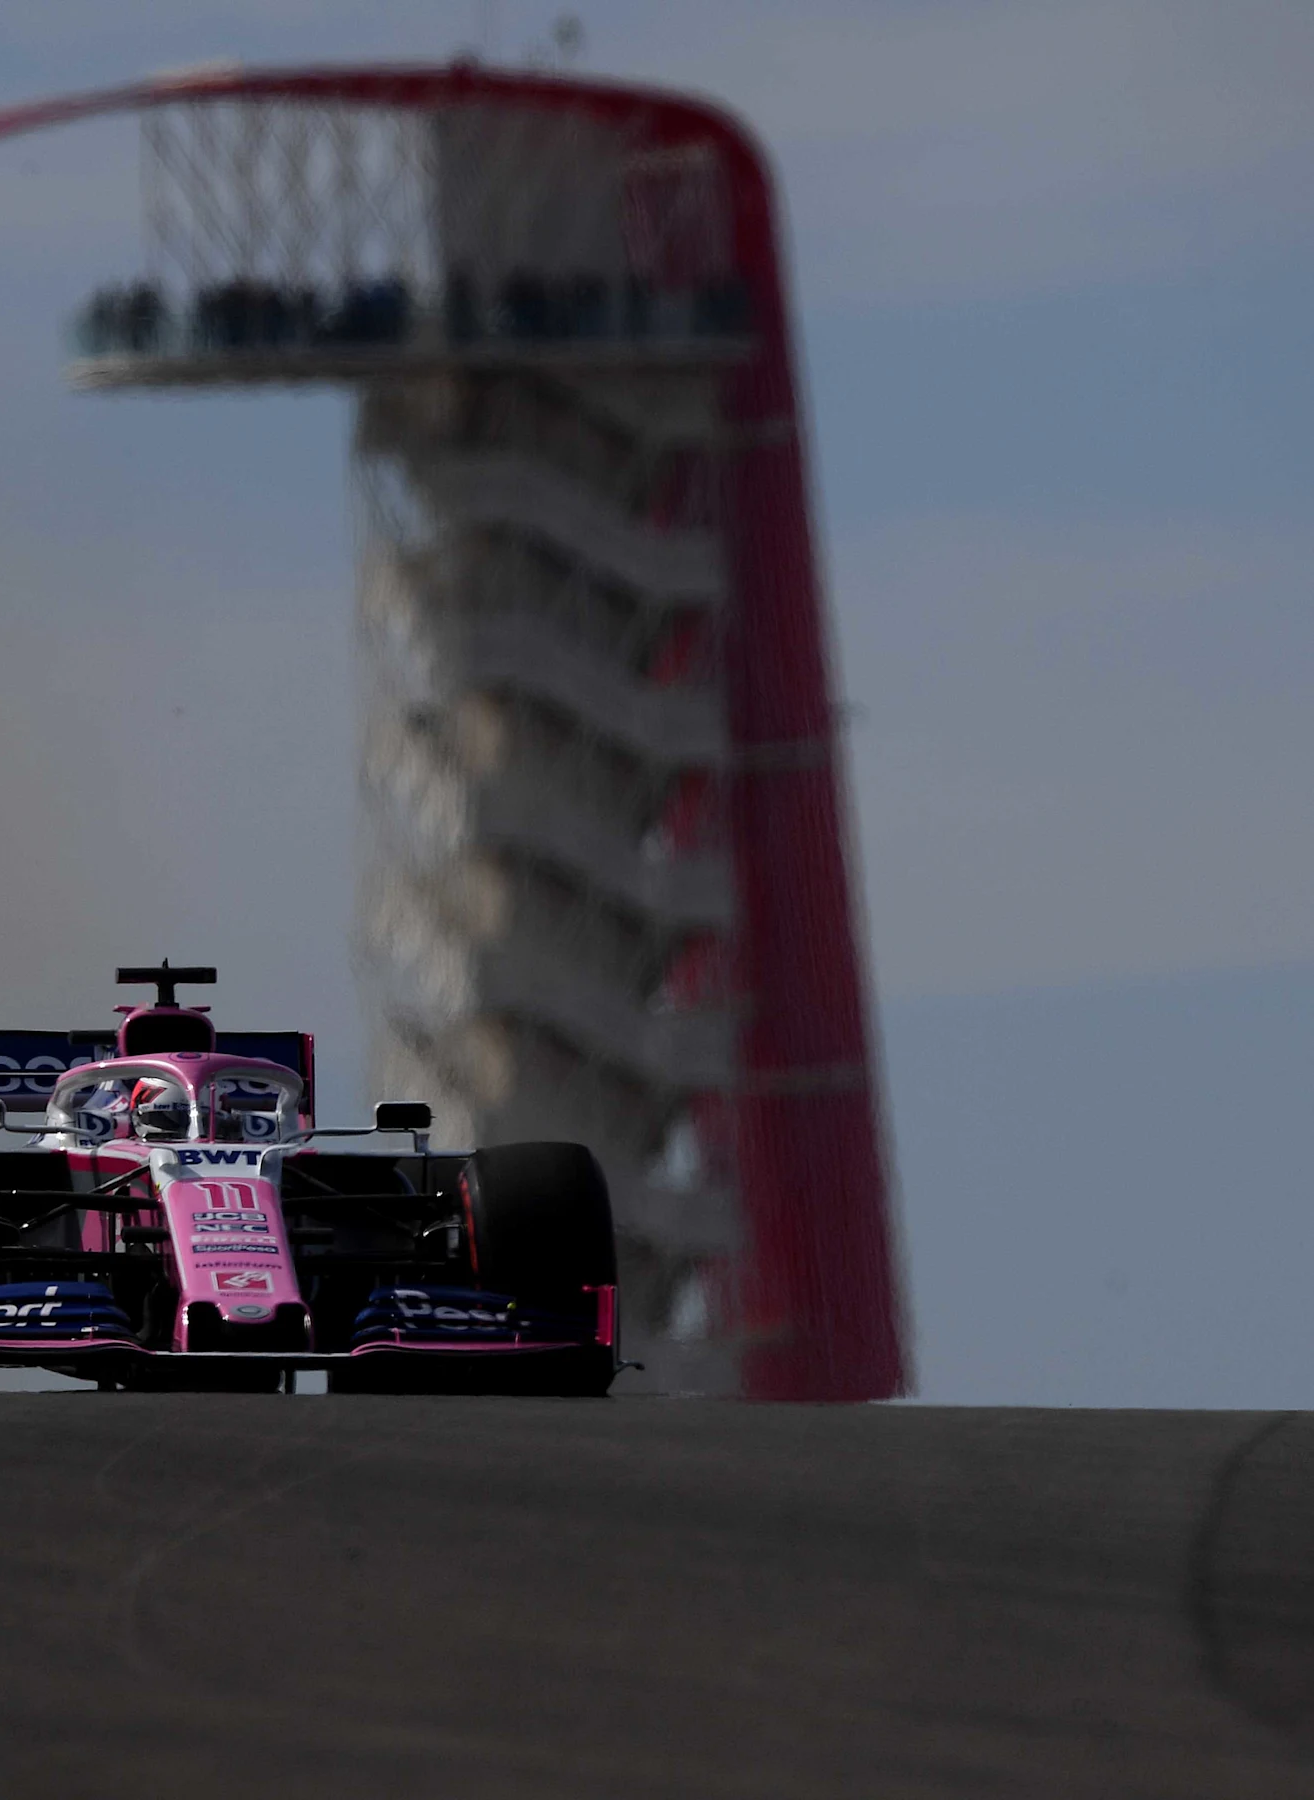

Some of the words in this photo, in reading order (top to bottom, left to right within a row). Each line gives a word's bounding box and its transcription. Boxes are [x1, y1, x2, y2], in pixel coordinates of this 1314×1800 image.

[177, 1150, 262, 1166] BWT
[193, 1182, 260, 1211] 11
[193, 1212, 267, 1222] JCB
[393, 1288, 532, 1331] Pes
